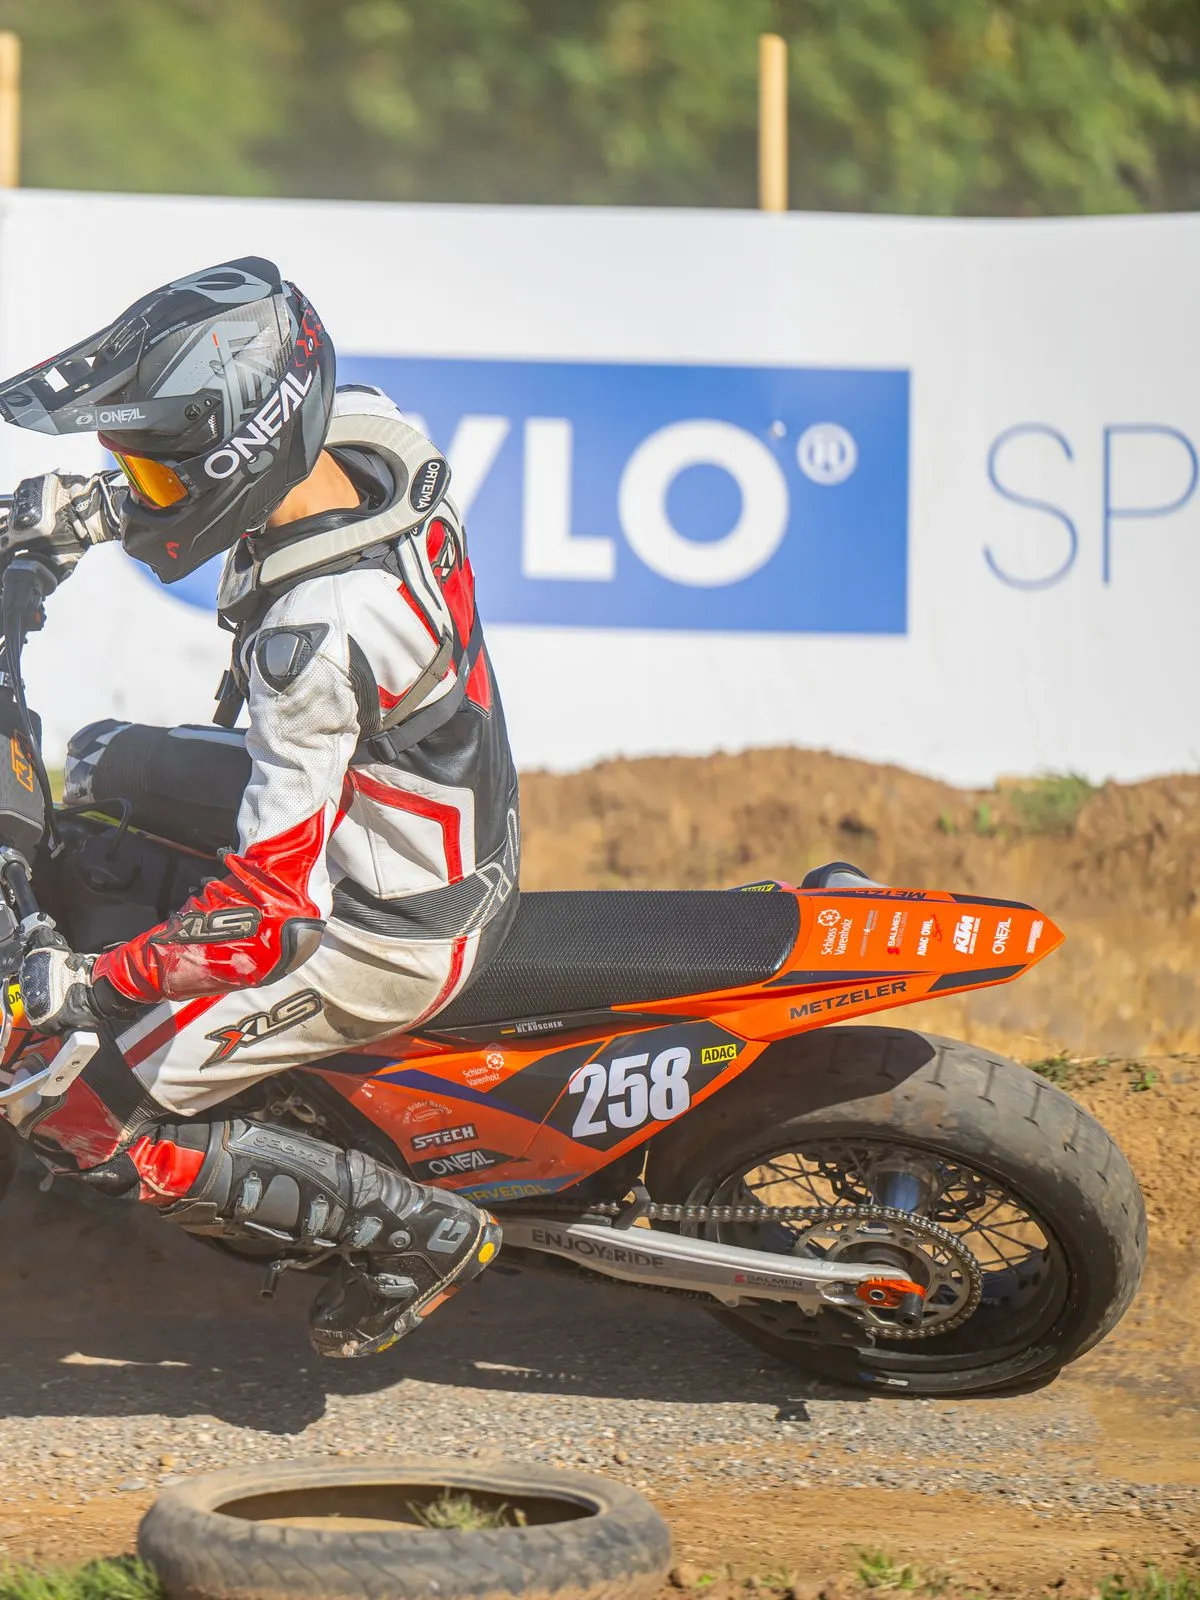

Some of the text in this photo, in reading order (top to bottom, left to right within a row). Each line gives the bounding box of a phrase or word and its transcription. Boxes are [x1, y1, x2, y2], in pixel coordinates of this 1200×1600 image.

[417, 461, 440, 509] ORTEMA
[821, 927, 838, 955] Schloss
[834, 918, 853, 955] Varenholz
[887, 911, 902, 947] SALMEN
[916, 918, 934, 956] ADAC OWL
[953, 915, 975, 954] KTM
[789, 980, 907, 1020] METZELER
[200, 988, 323, 1070] XLS
[462, 1066, 488, 1078] Schloss
[703, 1046, 736, 1063] ADAC
[466, 1073, 501, 1087] Varenholz
[568, 1047, 692, 1138] 258
[531, 1229, 607, 1258] ENJOY
[613, 1248, 664, 1268] RIDE
